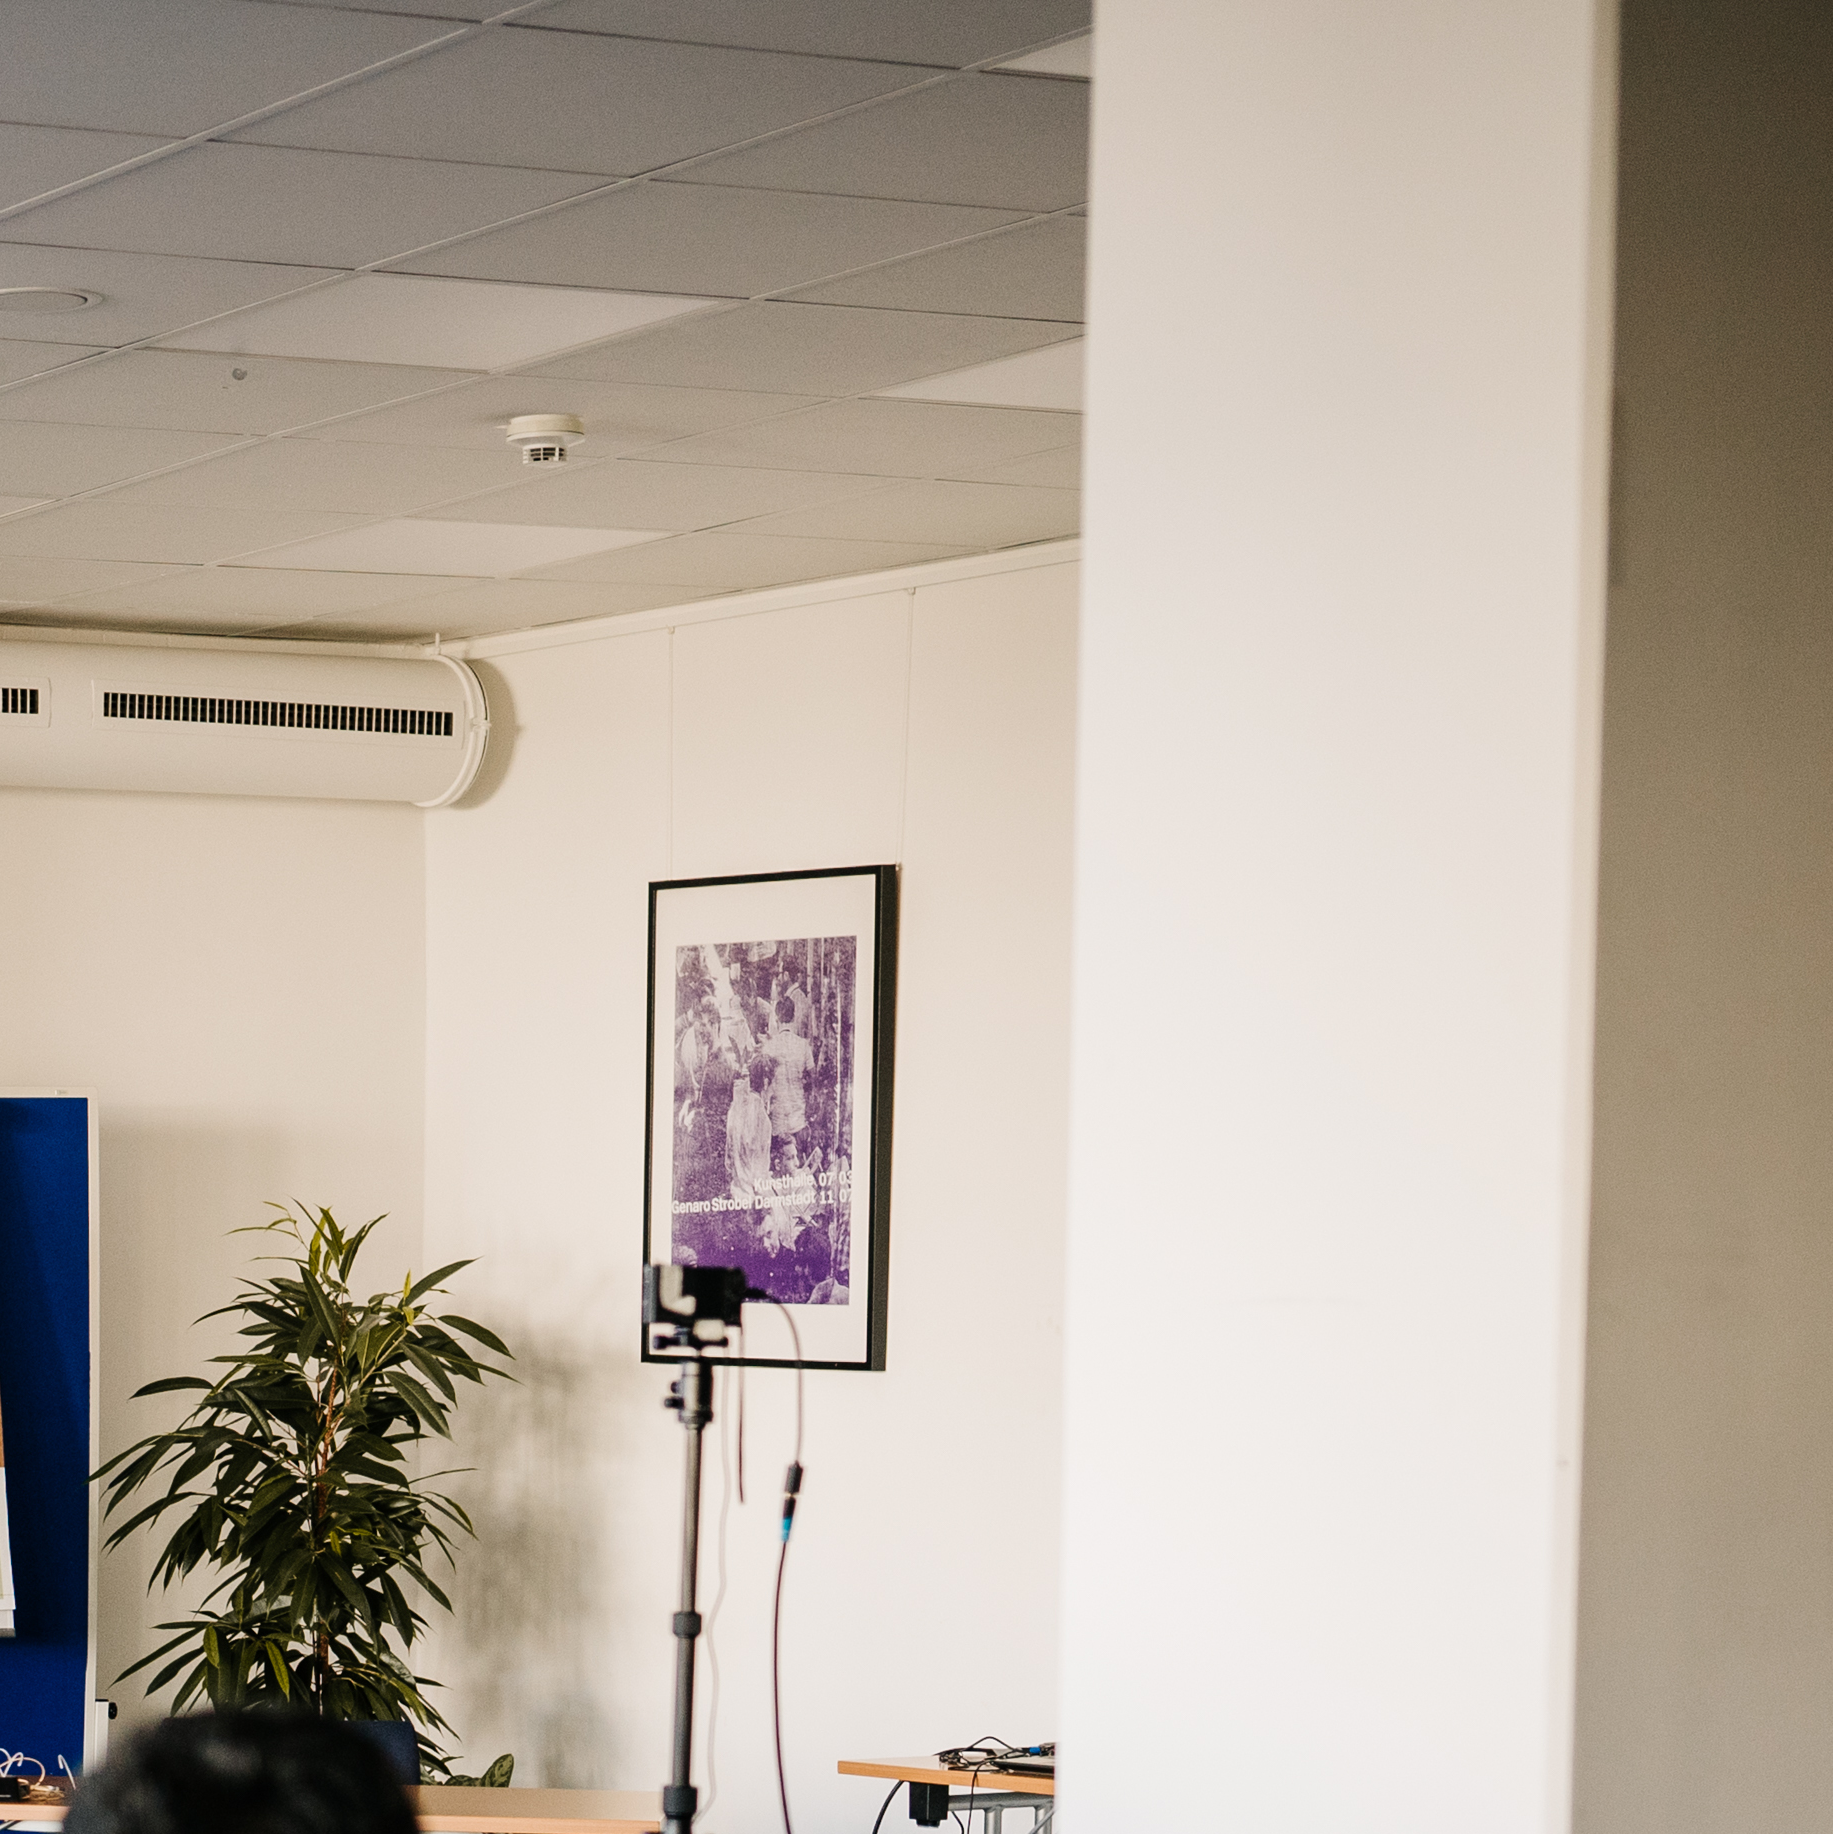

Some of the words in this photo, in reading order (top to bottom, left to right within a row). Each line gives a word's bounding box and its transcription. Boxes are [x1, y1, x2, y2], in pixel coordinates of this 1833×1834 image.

[754, 1172, 814, 1191] Kunsthalle
[819, 1172, 834, 1186] 07
[672, 1200, 710, 1214] Genaro
[712, 1197, 753, 1211] Strobel
[755, 1192, 815, 1210] Darmstadt
[820, 1192, 834, 1204] 11
